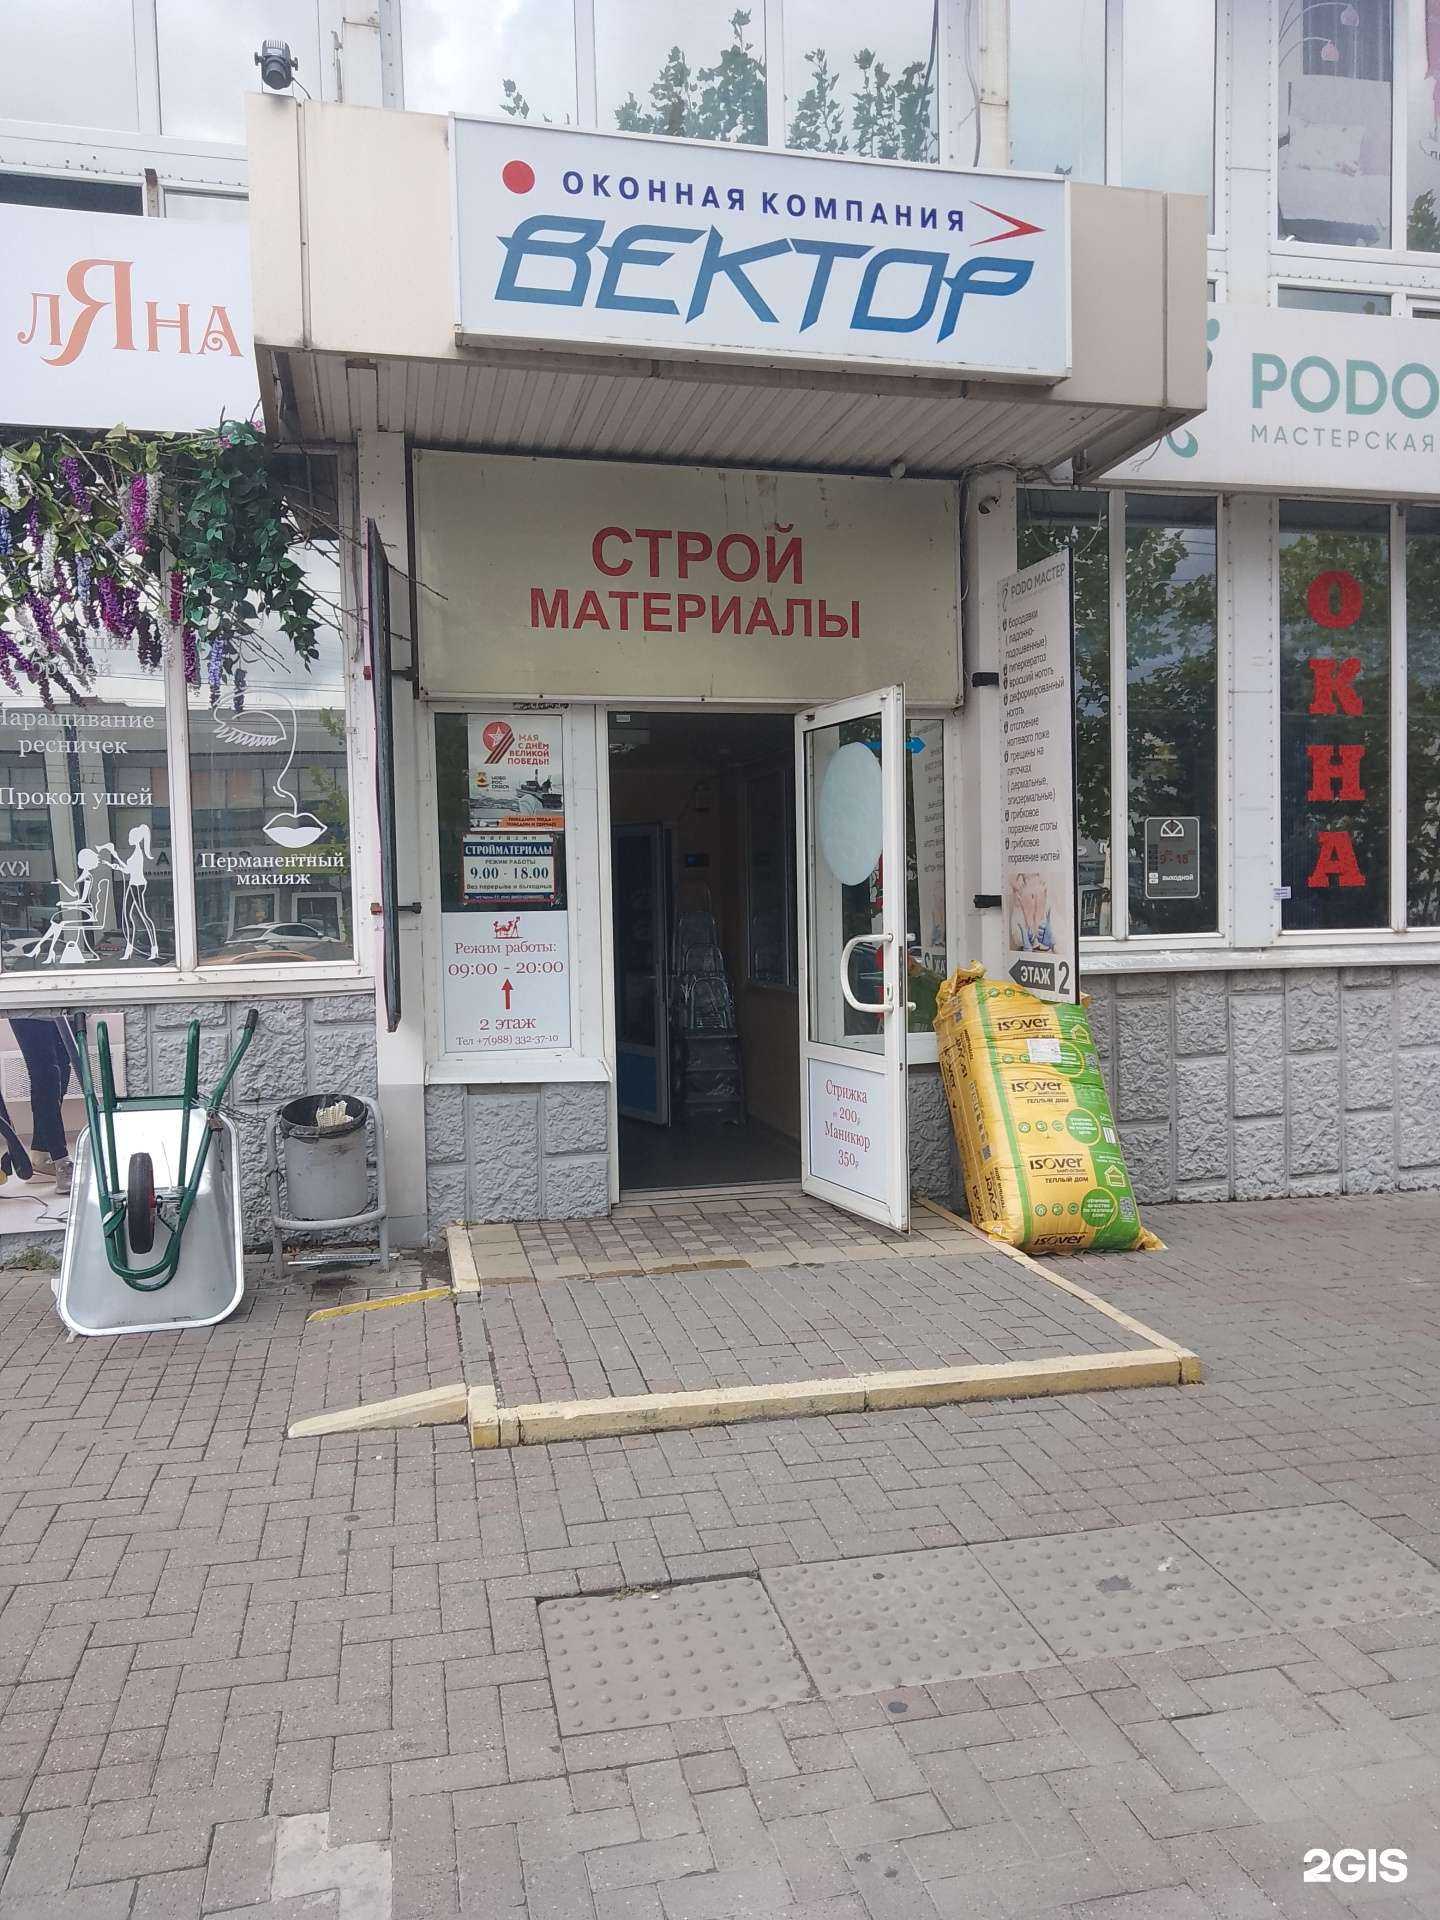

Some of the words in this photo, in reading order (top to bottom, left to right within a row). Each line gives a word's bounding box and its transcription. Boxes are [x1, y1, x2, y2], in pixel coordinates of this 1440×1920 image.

[562, 170, 745, 211] ОКОННАЯ
[762, 192, 964, 232] КОМПАНИЯ
[495, 215, 1034, 344] ВЕКТОР
[1251, 352, 1440, 419] PODO
[1251, 424, 1434, 452] МАСТЕРСКАЯ
[592, 523, 803, 585] СТРОЙ
[1034, 563, 1066, 587] МАСТЕР
[530, 588, 860, 638] МАТЕРИАЛЫ
[1306, 569, 1367, 888] ОКНА
[18, 738, 128, 758] ресничек
[509, 749, 550, 757] ВЕЛИКОЙ
[507, 757, 550, 766] ПОБЕДЫ!
[0, 787, 86, 809] Прокол
[93, 787, 154, 809] ушей
[465, 844, 552, 855] СТРОЙМАТЕРИАЛЫ
[200, 852, 345, 870] Перманентный
[236, 872, 311, 886] макияж
[470, 866, 499, 880] 9.00
[513, 866, 549, 880] 18.00
[455, 942, 501, 954] Режим
[505, 941, 557, 956] работы:
[448, 963, 498, 979] 09:00
[515, 961, 564, 974] 20:00
[1020, 965, 1051, 985] ЭТАЖ
[1058, 961, 1071, 995] 2
[480, 1018, 490, 1031] 2
[495, 1018, 537, 1030] этаж
[515, 1034, 559, 1045] 332-37-10
[825, 1079, 868, 1104] Стрижка
[825, 1120, 871, 1153] Маникюр
